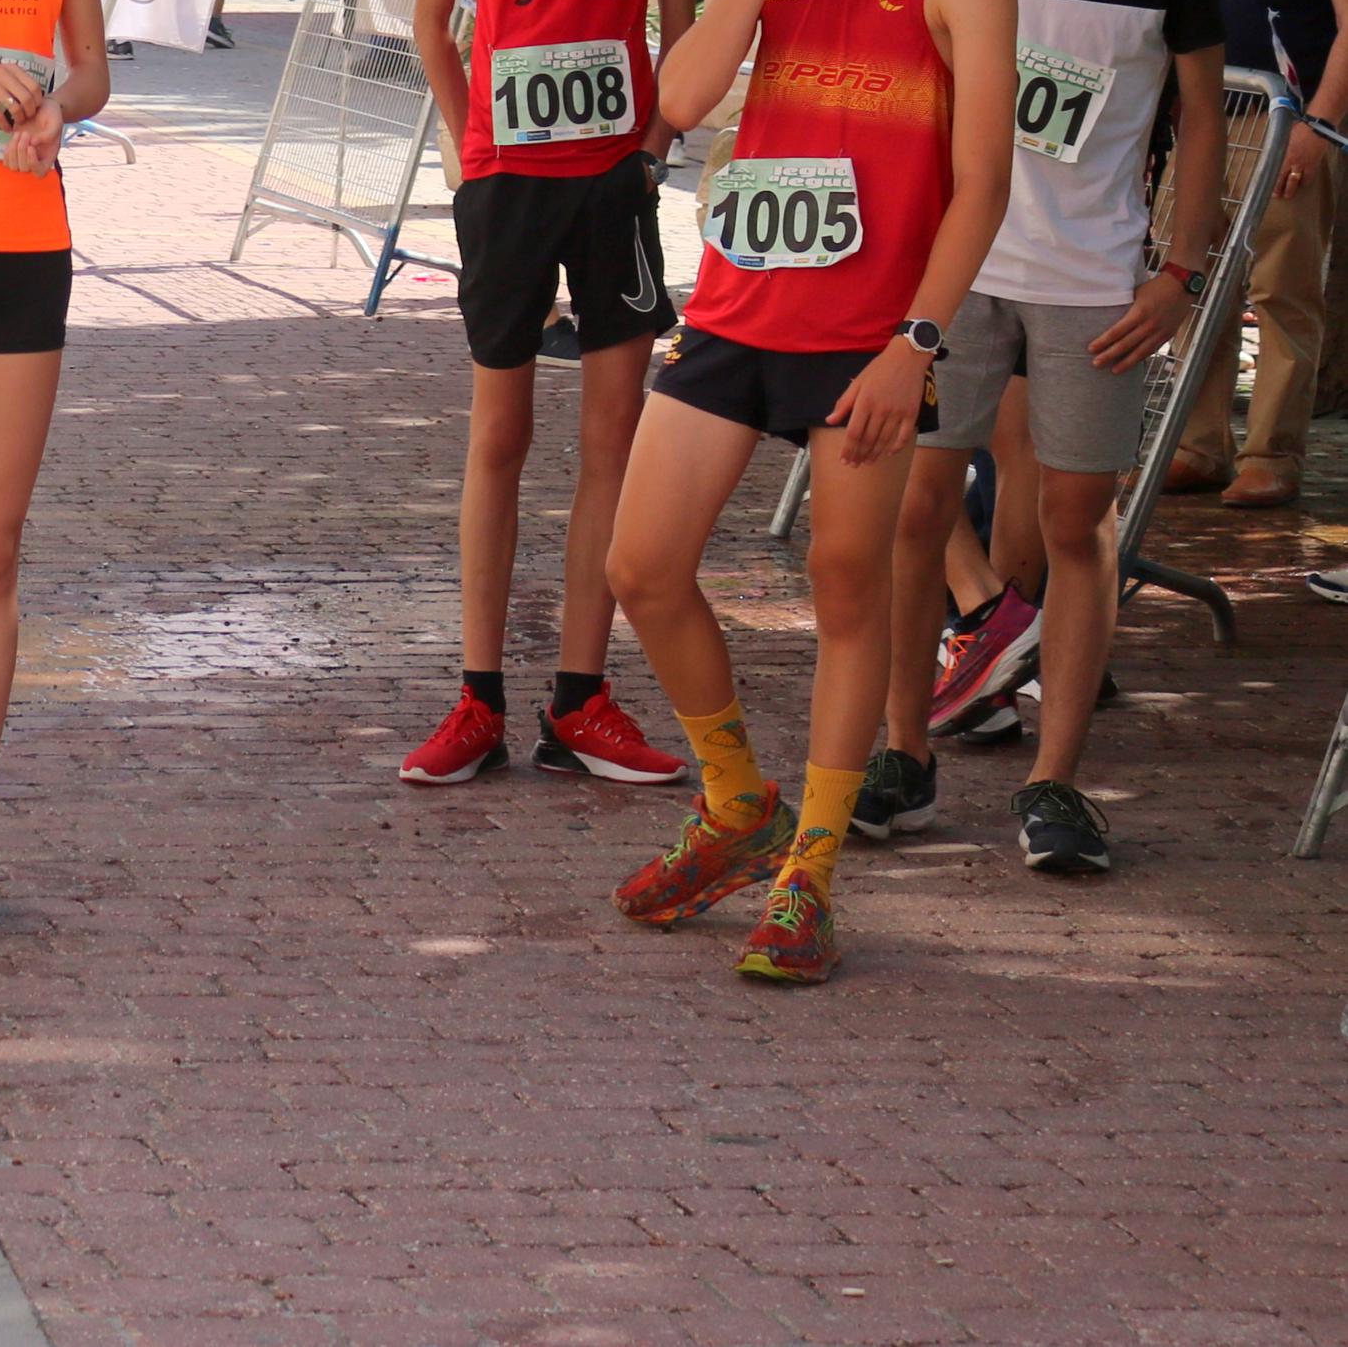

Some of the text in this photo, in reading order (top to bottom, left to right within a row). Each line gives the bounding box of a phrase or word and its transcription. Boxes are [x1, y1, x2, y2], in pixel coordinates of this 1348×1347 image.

[496, 60, 529, 69] LEN
[496, 67, 530, 75] CIA
[495, 66, 628, 130] 1008
[1016, 77, 1093, 147] 01
[717, 181, 755, 189] CIA
[711, 190, 858, 254] 1005
